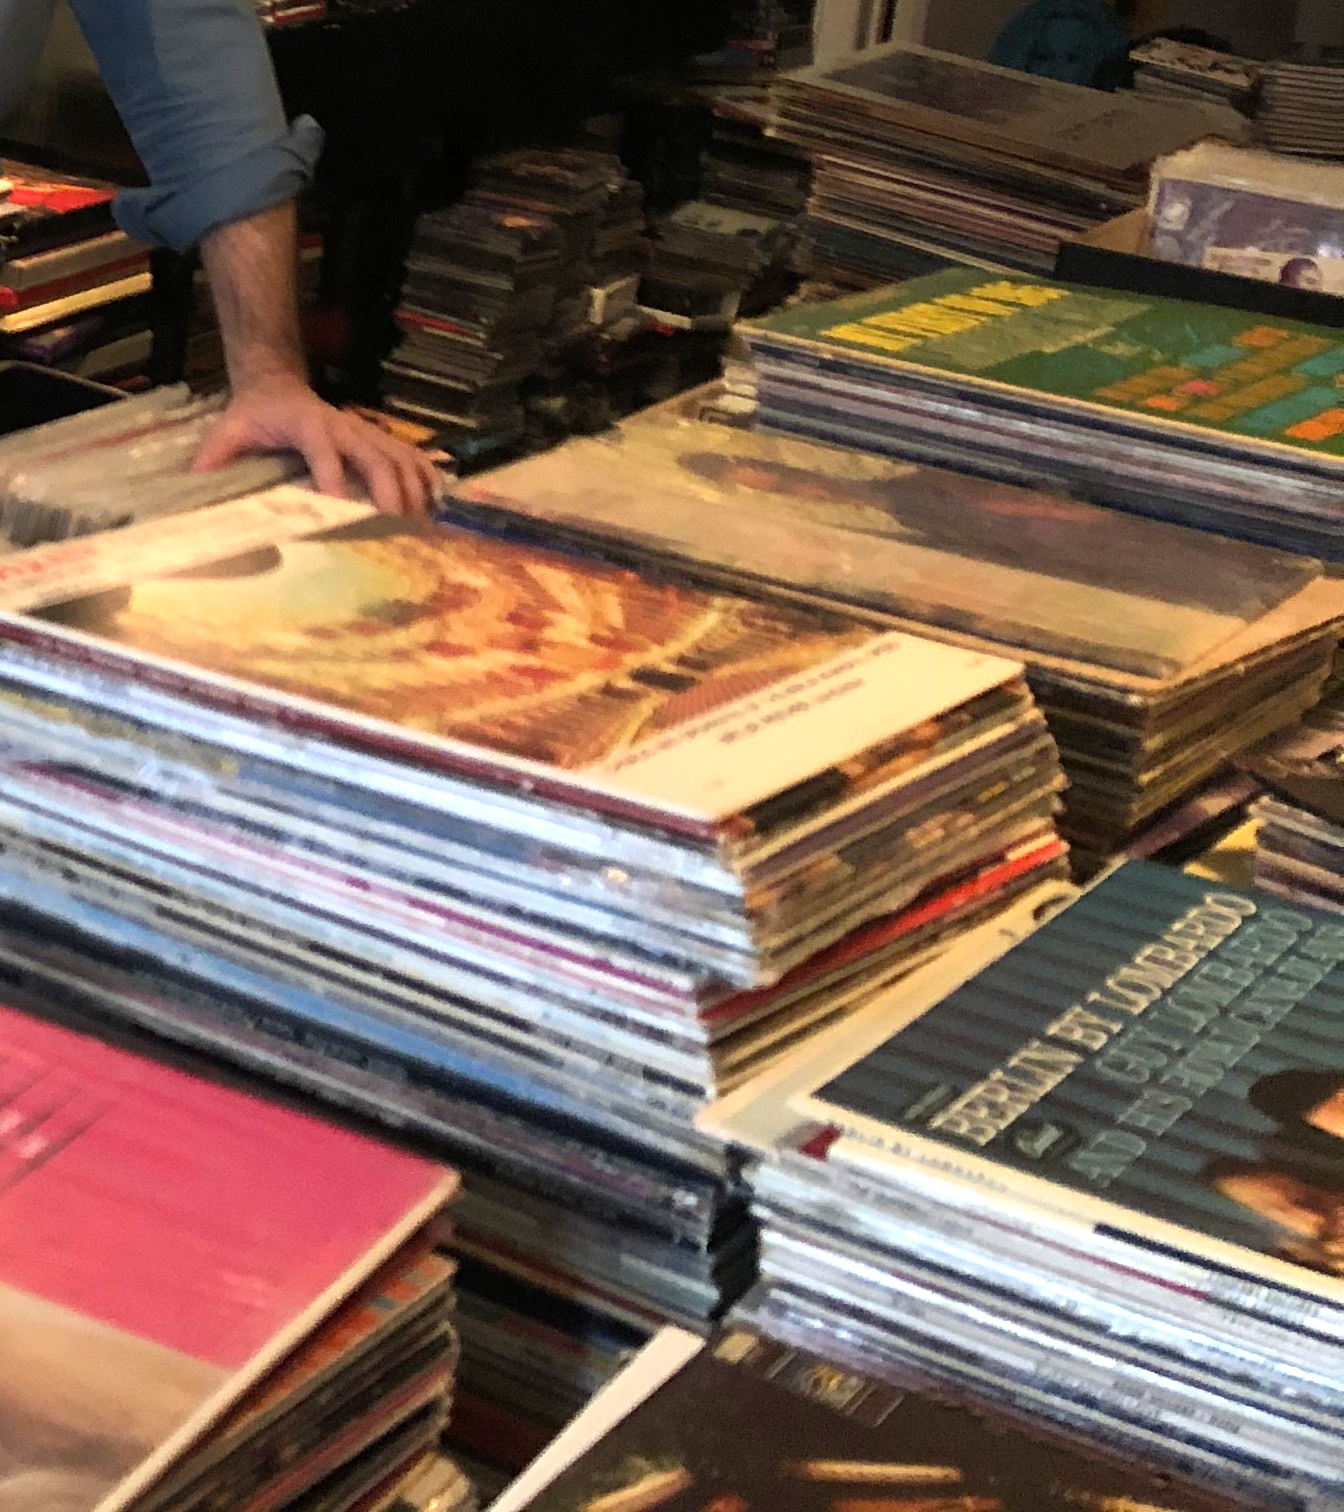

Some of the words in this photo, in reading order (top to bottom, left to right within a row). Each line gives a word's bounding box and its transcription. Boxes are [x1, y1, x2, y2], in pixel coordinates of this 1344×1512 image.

[928, 1039, 1085, 1146] BERLIN
[1045, 1003, 1124, 1052] BY
[1087, 891, 1257, 1015] LOMBARDO
[1094, 1025, 1193, 1084] GUY
[1149, 907, 1314, 1035] LOMBARDO
